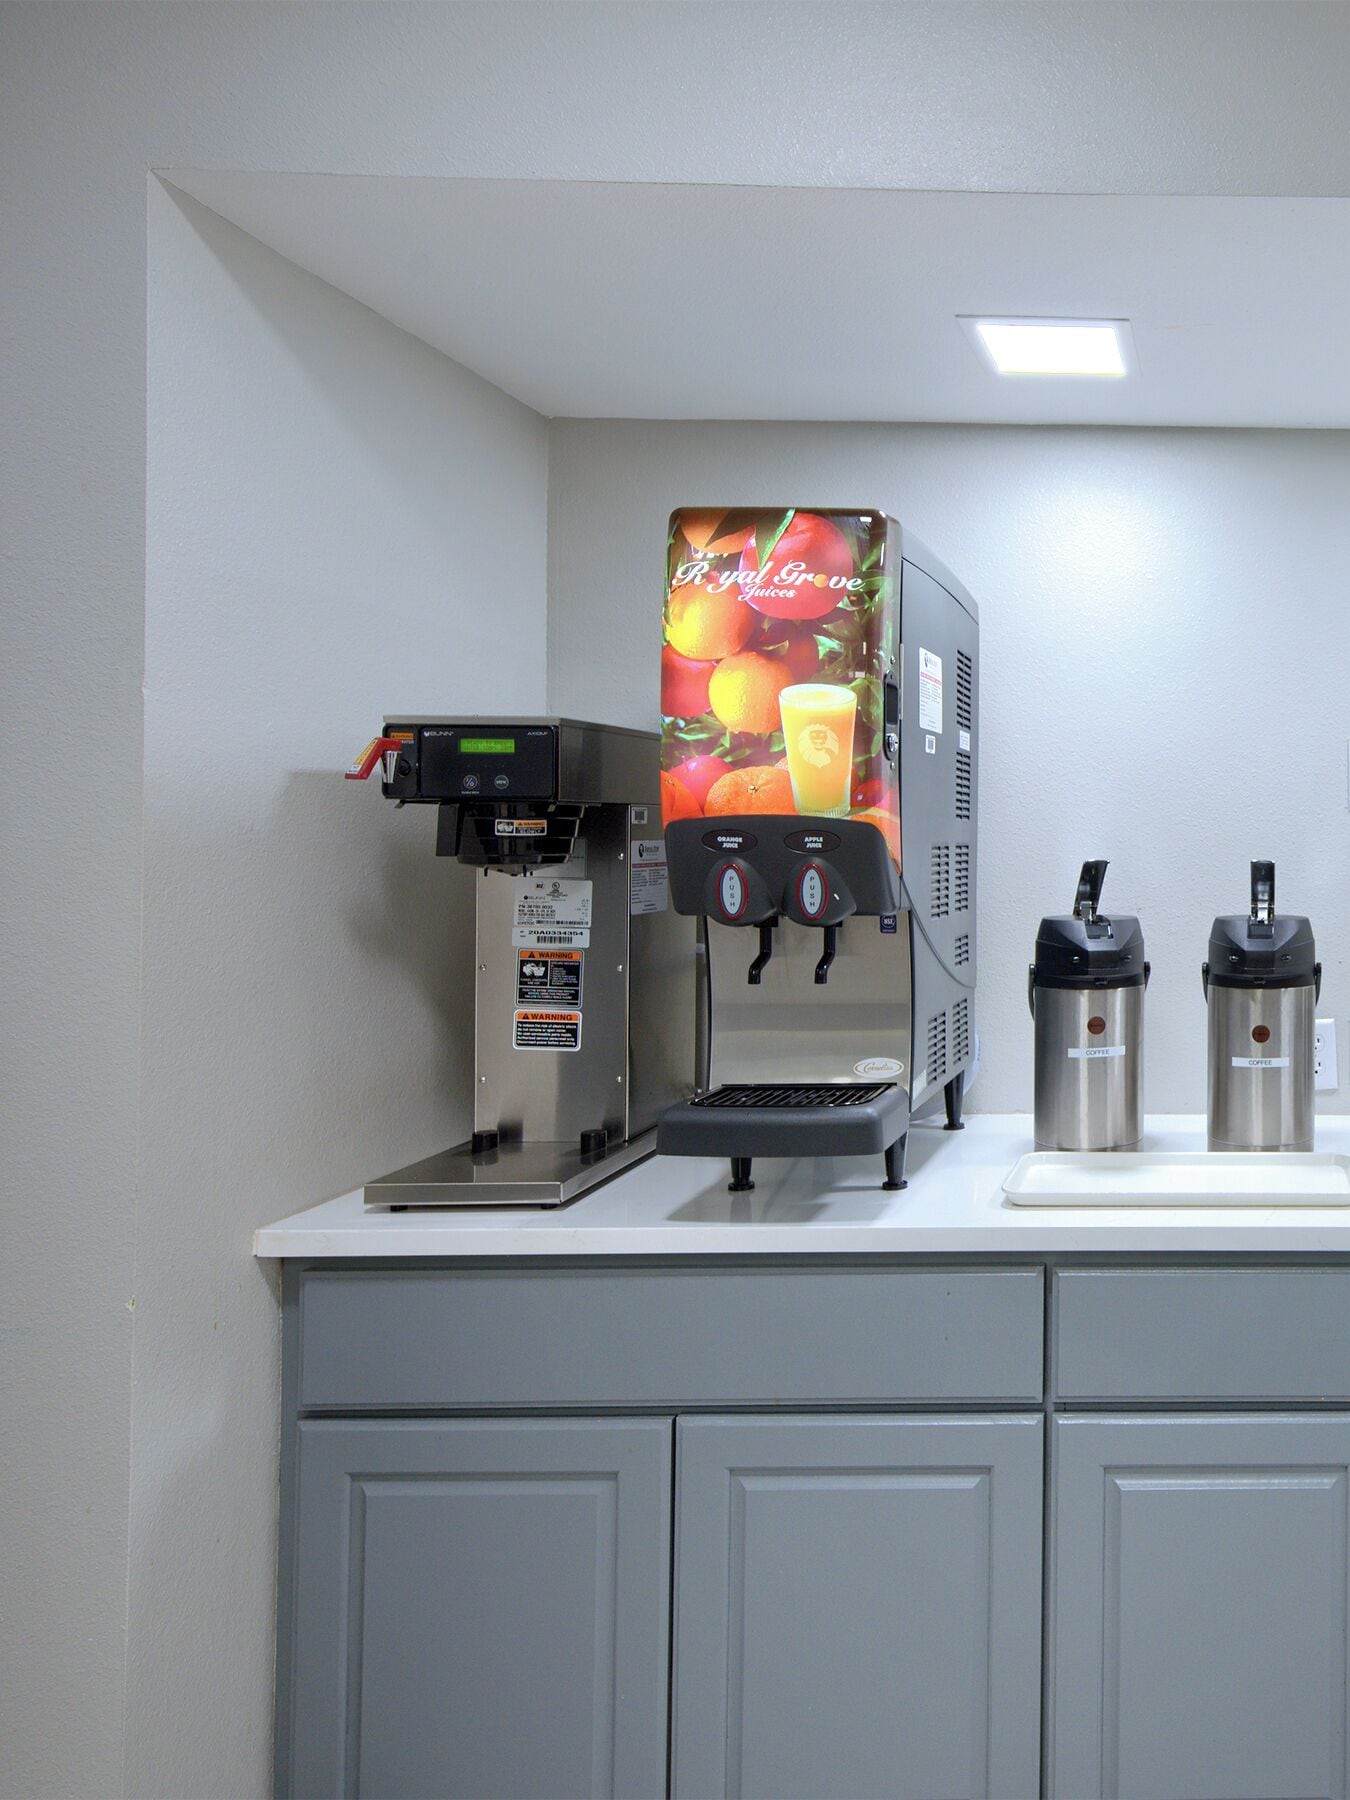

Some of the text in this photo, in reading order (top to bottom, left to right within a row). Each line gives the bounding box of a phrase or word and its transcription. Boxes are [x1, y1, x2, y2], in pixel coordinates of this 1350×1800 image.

[672, 559, 866, 593] Royal Grove
[738, 583, 797, 601] Juices
[728, 876, 736, 907] PUSH
[538, 951, 573, 959] WARNING
[531, 1013, 573, 1021] WARNING
